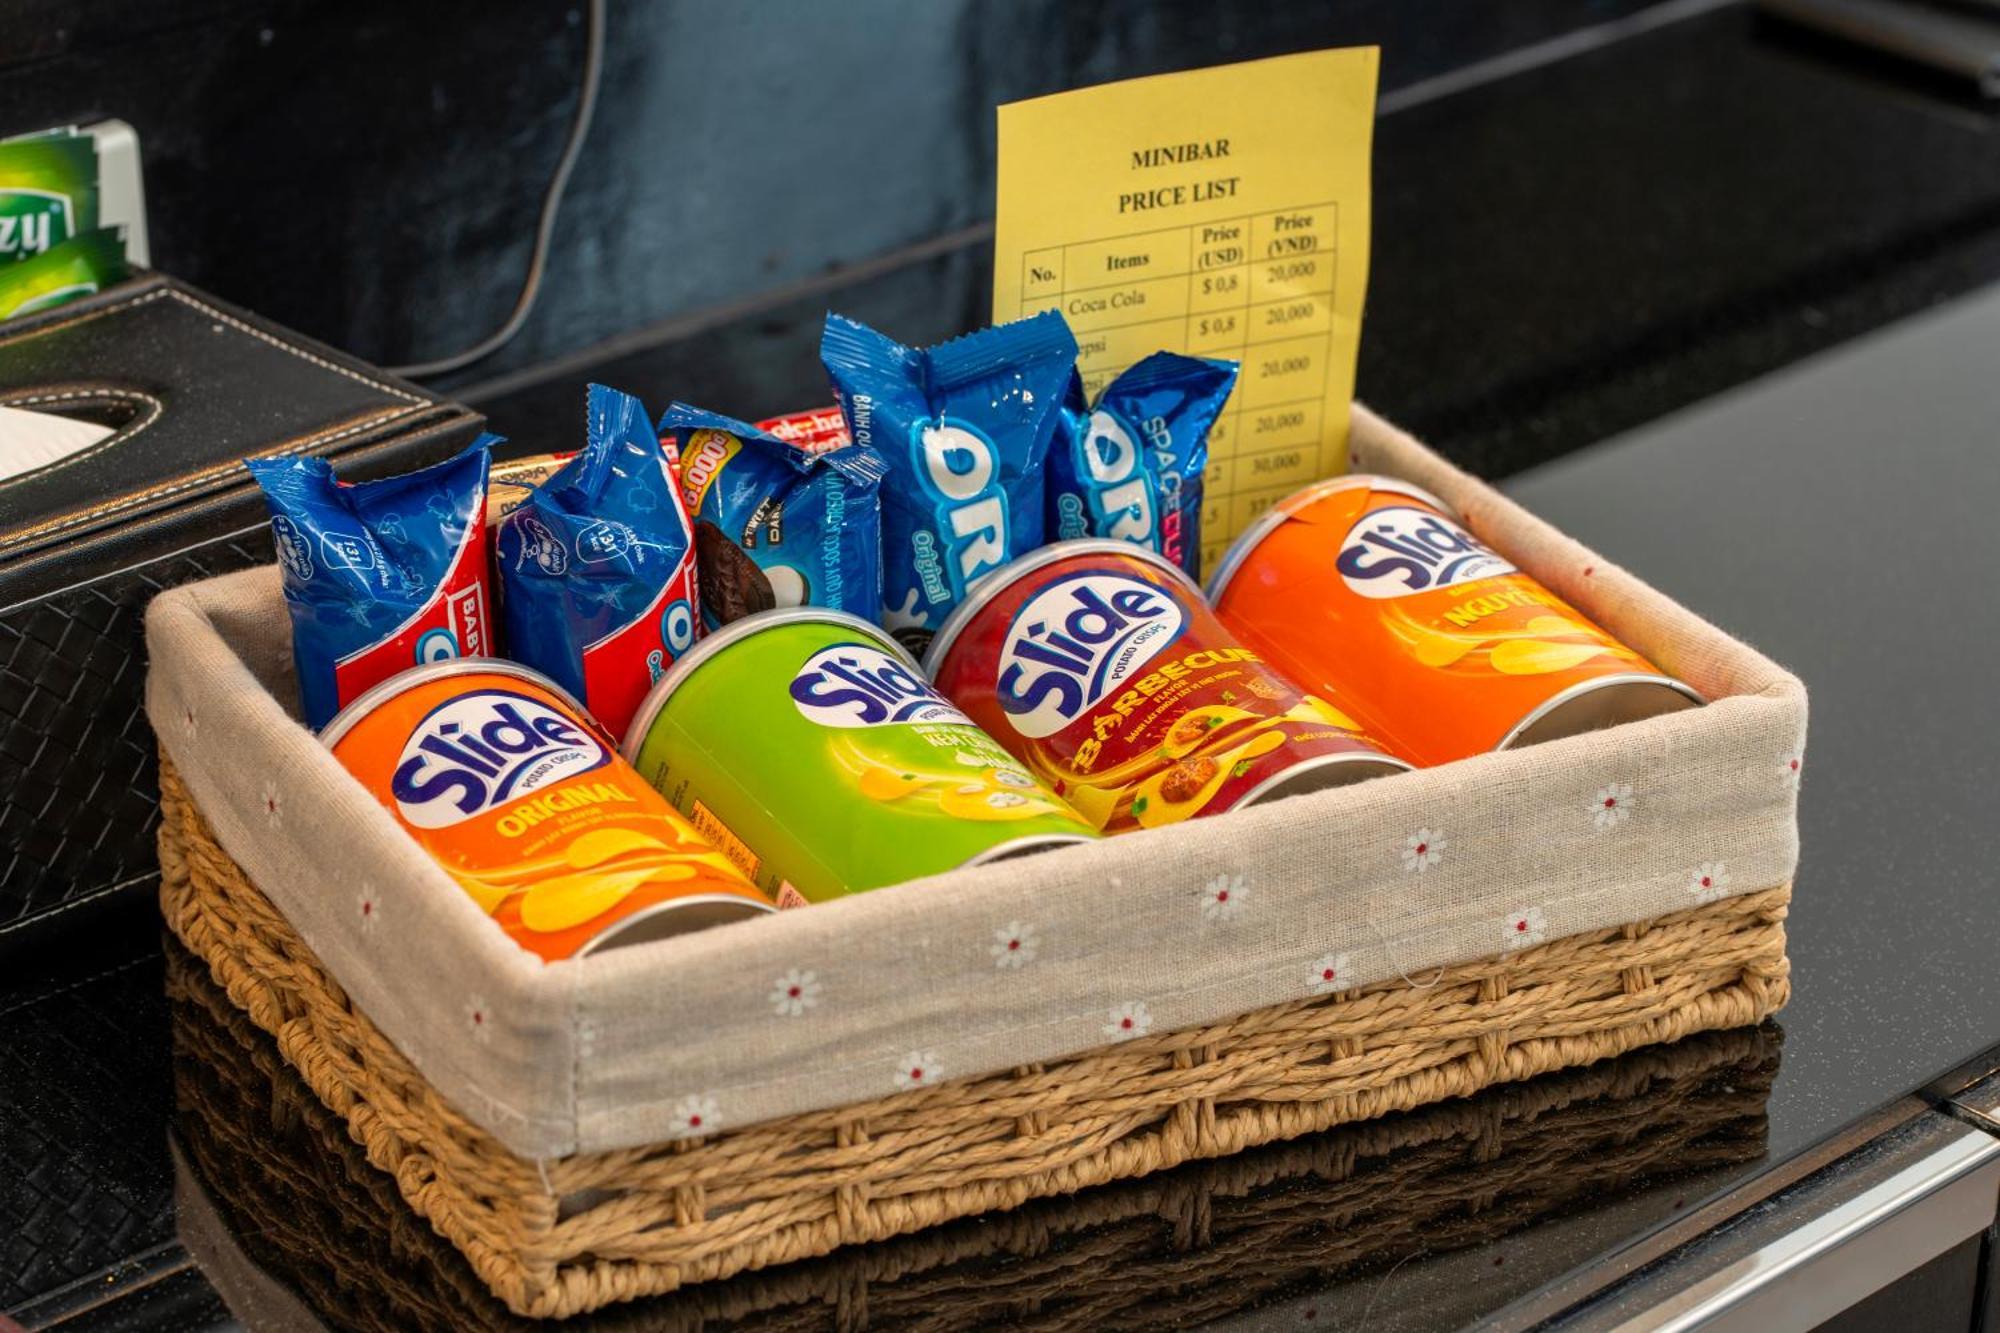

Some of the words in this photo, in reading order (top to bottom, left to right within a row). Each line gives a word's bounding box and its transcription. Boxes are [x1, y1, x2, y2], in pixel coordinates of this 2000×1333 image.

[1131, 138, 1231, 169] MINIBAR
[1118, 184, 1186, 214] PRICE
[1192, 177, 1242, 203] LIST
[1202, 225, 1241, 245] Price
[1274, 213, 1314, 233] Price
[1199, 246, 1244, 272] (USD)
[1267, 235, 1318, 260] (VND)
[1030, 265, 1057, 284] No.
[1106, 252, 1150, 272] Items
[1068, 296, 1107, 317] Coca
[1111, 290, 1146, 309] Cola
[1083, 410, 1156, 549] OR
[922, 426, 1006, 594] OR
[913, 533, 948, 602] Original
[998, 585, 1167, 721] Slide
[1112, 646, 1137, 682] POTATO
[1134, 622, 1168, 656] CRISPS
[1070, 646, 1266, 772] BARBECUE
[391, 702, 587, 815] Slide
[521, 762, 555, 789] POTATO
[495, 782, 639, 838] ORIGINAL
